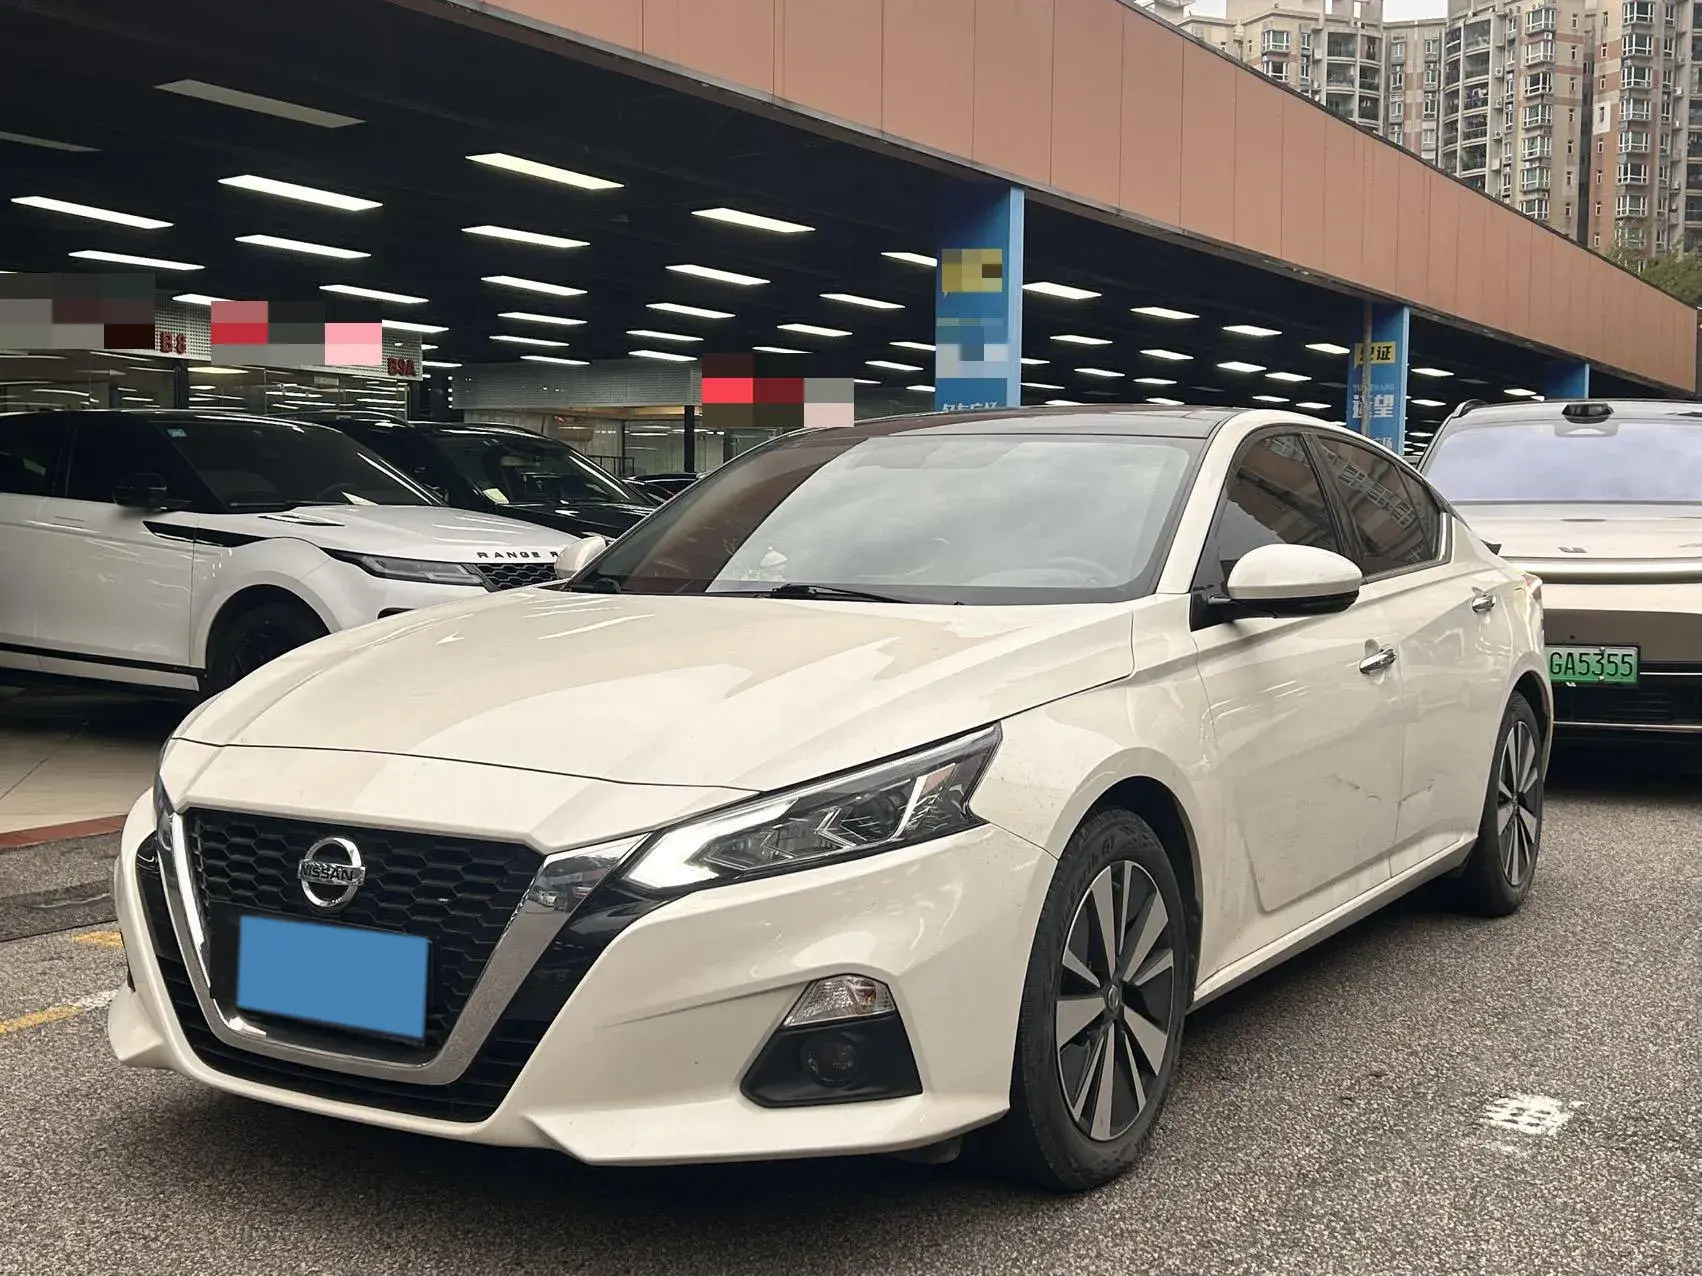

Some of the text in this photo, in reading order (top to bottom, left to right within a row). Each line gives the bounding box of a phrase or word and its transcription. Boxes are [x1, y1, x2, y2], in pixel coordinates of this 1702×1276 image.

[476, 551, 541, 559] RANGE
[1550, 651, 1633, 677] GA5355
[300, 862, 354, 882] NISSAN
